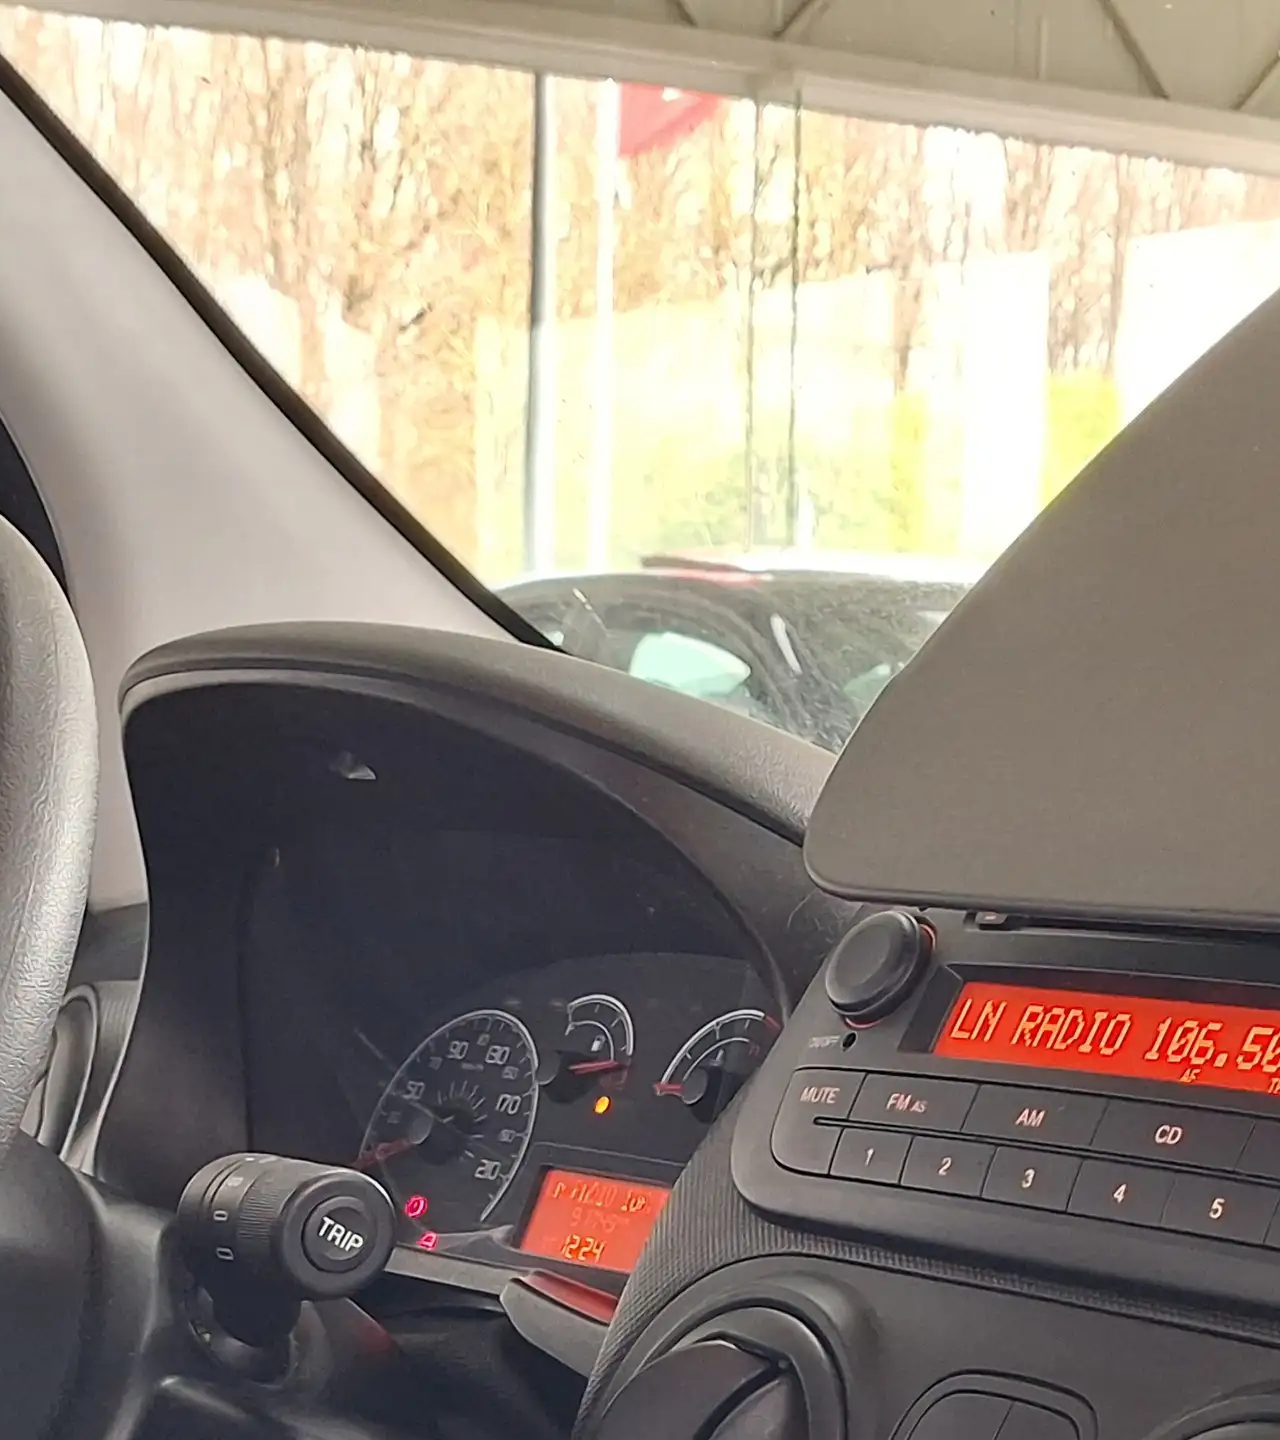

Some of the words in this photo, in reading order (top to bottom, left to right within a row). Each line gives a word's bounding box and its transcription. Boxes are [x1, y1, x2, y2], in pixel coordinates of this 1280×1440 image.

[949, 998, 1007, 1042] LN
[1010, 1004, 1132, 1055] RADIO
[799, 1086, 841, 1105] MUTE
[885, 1093, 912, 1112] FM
[1014, 1107, 1046, 1128] AM
[1154, 1124, 1182, 1145] CD
[864, 1147, 874, 1167] 1
[937, 1157, 952, 1176] 2
[1021, 1168, 1037, 1189] 3
[1112, 1183, 1128, 1203] 4
[1208, 1197, 1226, 1219] 5
[317, 1215, 364, 1252] TRIP
